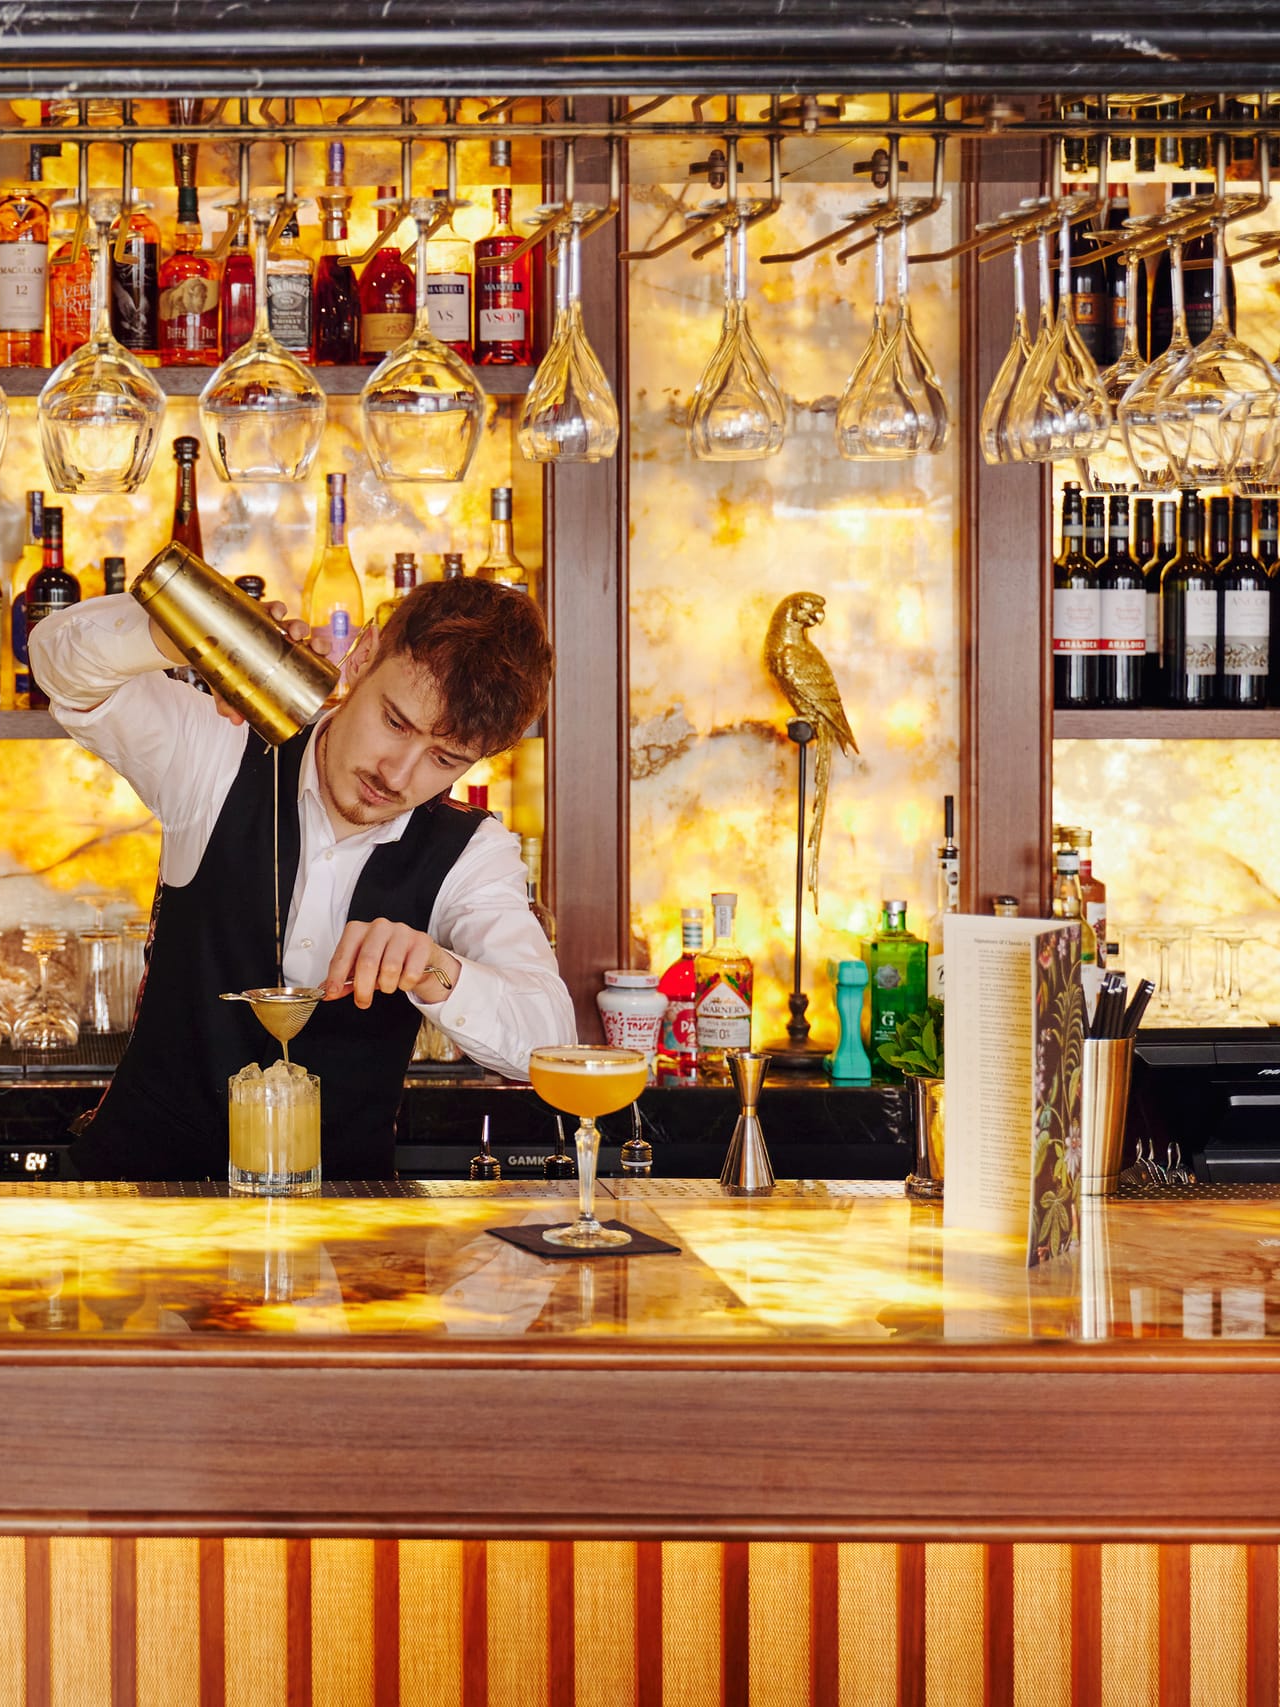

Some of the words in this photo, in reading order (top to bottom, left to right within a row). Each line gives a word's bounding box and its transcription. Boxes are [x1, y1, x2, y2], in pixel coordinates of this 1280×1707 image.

[15, 284, 28, 296] 12
[436, 310, 454, 321] VS
[485, 312, 520, 325] VSOP
[680, 1020, 696, 1033] PA
[507, 1155, 546, 1166] GAMK
